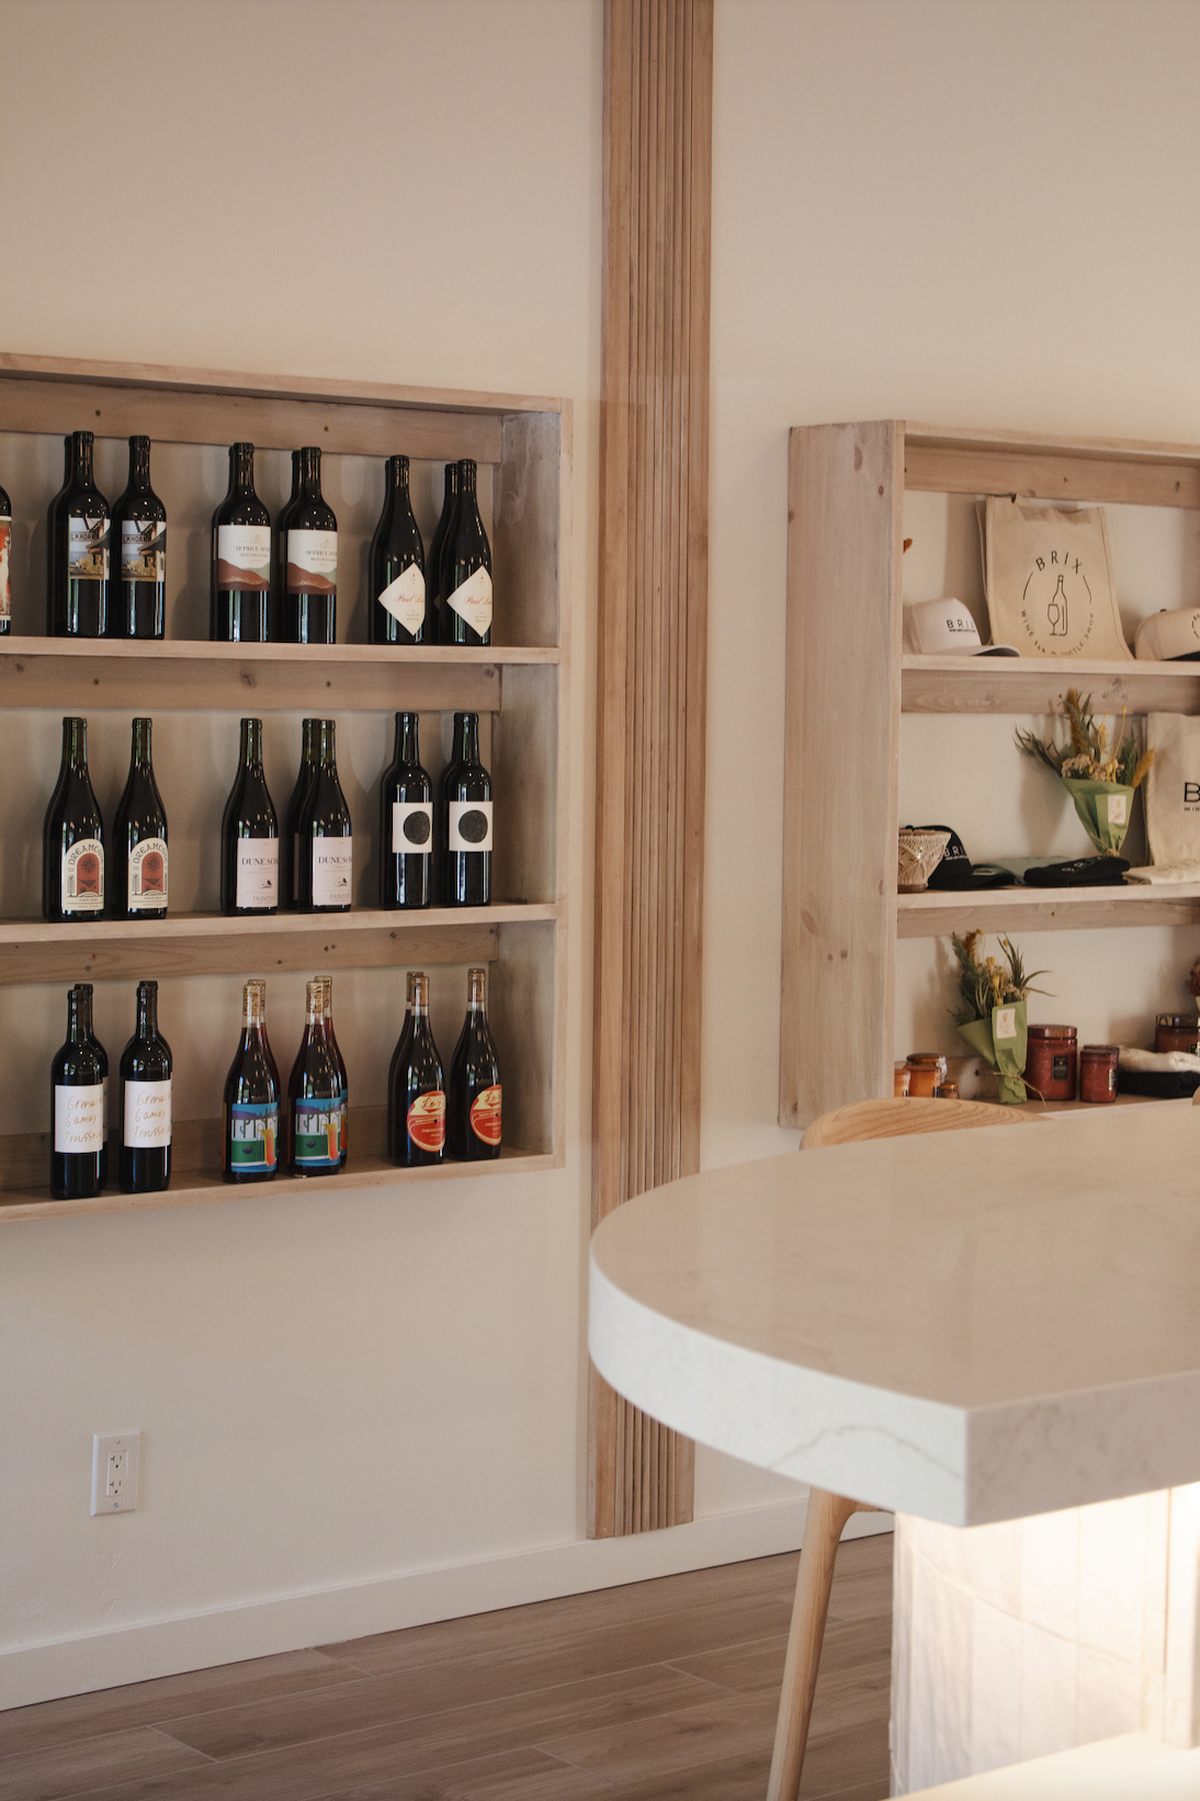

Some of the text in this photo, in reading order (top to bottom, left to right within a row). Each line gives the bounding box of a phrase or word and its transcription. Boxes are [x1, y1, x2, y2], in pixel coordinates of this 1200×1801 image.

[1036, 550, 1082, 574] BRIX
[241, 858, 265, 866] DUNE
[318, 856, 341, 864] DUNE
